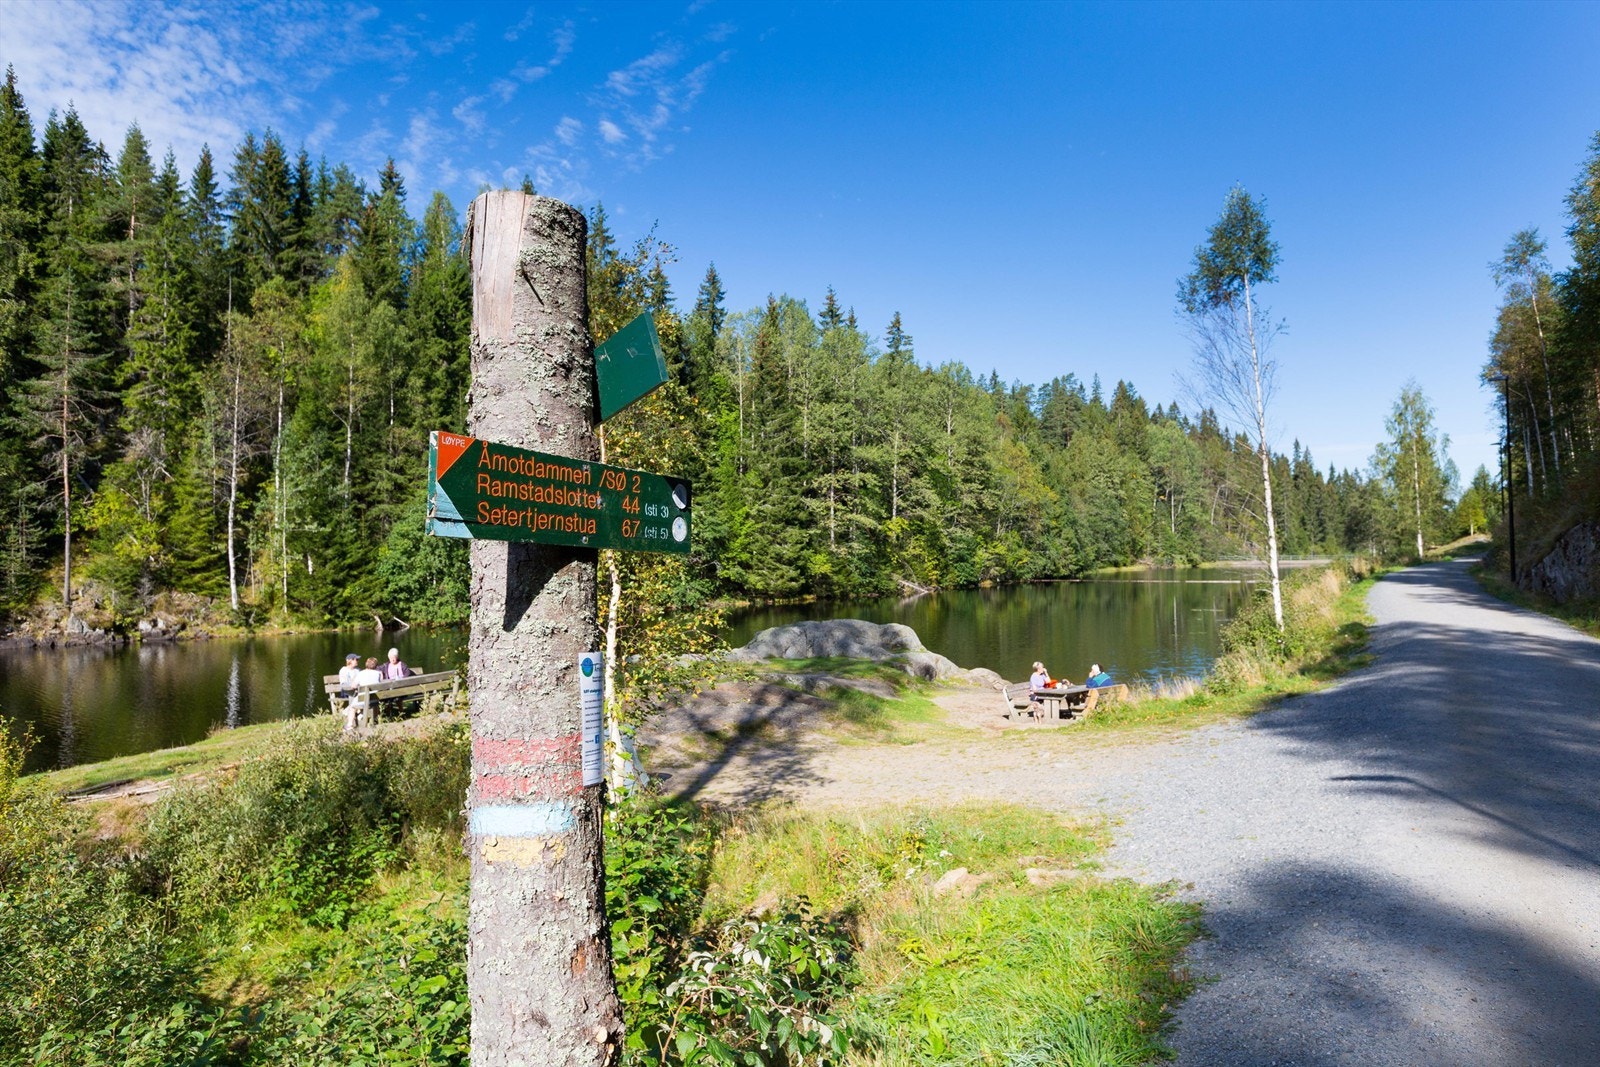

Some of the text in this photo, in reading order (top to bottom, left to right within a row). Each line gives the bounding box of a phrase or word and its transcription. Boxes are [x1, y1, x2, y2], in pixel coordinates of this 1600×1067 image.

[441, 436, 466, 448] LØYPE
[478, 440, 591, 486] Åmotdammen
[632, 474, 641, 494] 2
[476, 473, 602, 510] Ramstadslottet
[645, 503, 658, 517] (sti
[660, 506, 669, 518] 3)
[476, 501, 597, 534] Setertjernstua
[660, 528, 669, 539] 5)
